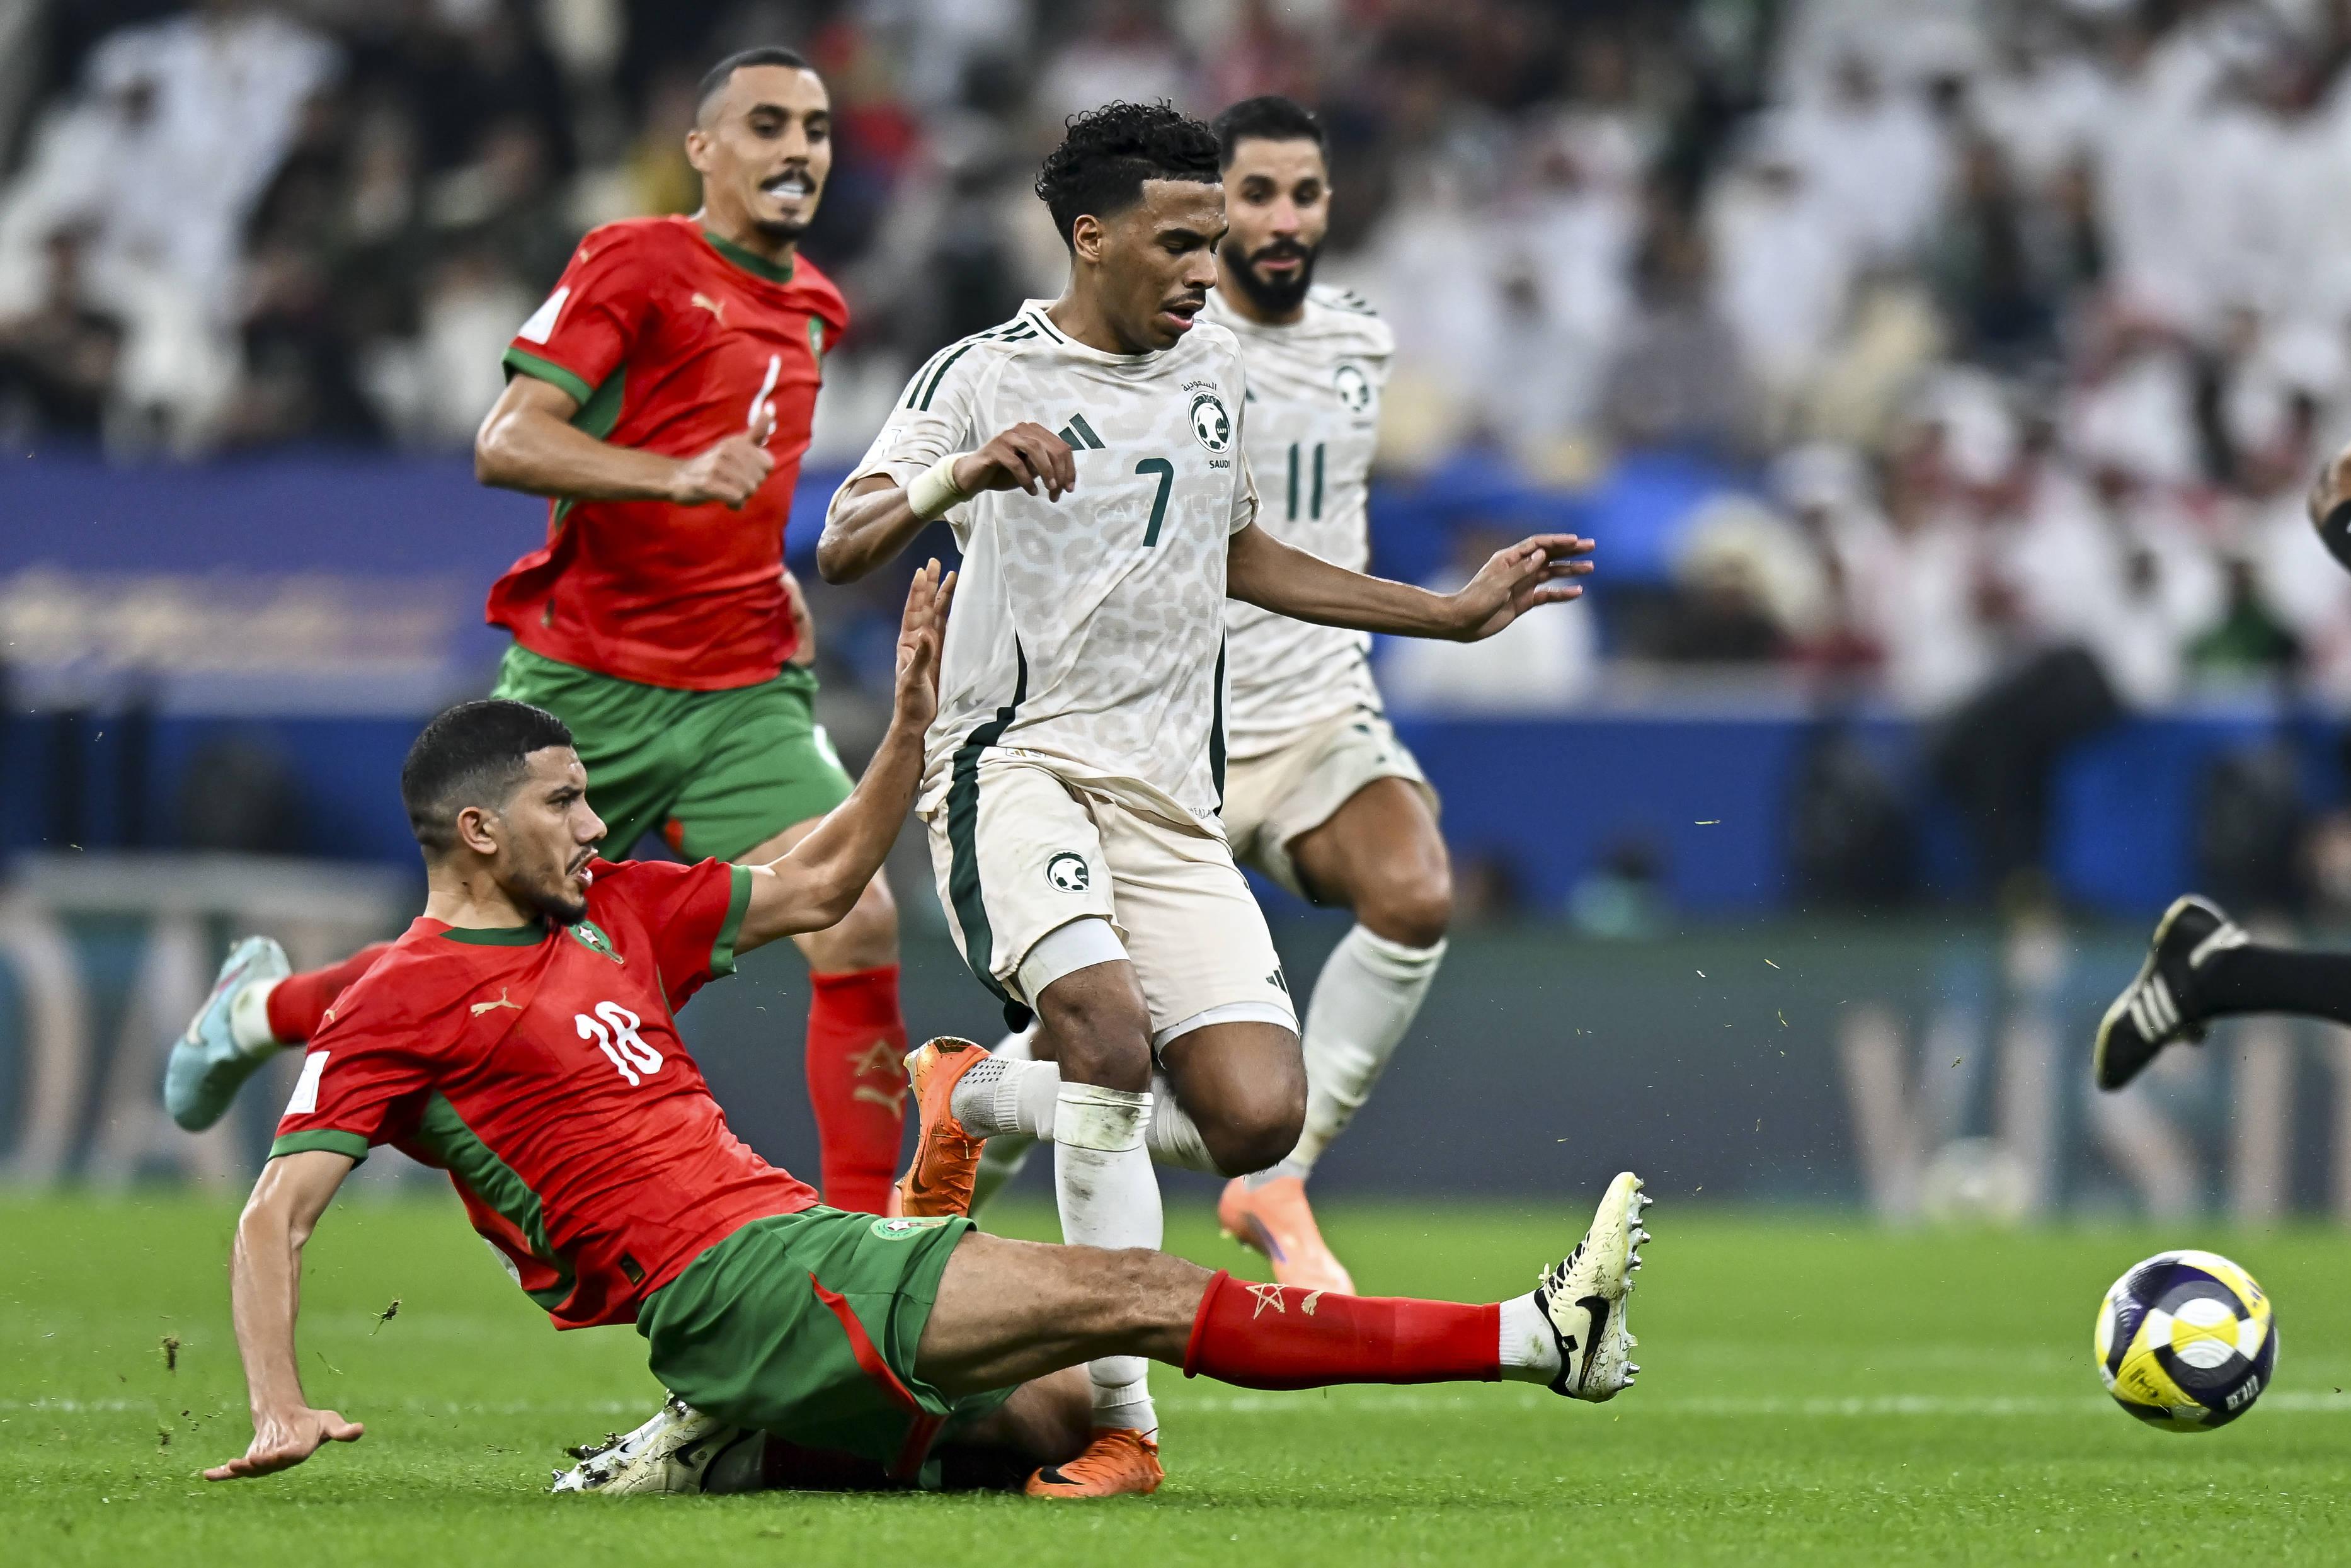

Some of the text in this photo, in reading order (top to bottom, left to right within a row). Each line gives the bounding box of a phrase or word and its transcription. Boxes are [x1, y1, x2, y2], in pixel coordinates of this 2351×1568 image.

[1135, 457, 1174, 547] 7
[1287, 442, 1324, 521] 11
[574, 1000, 663, 1087] 18
